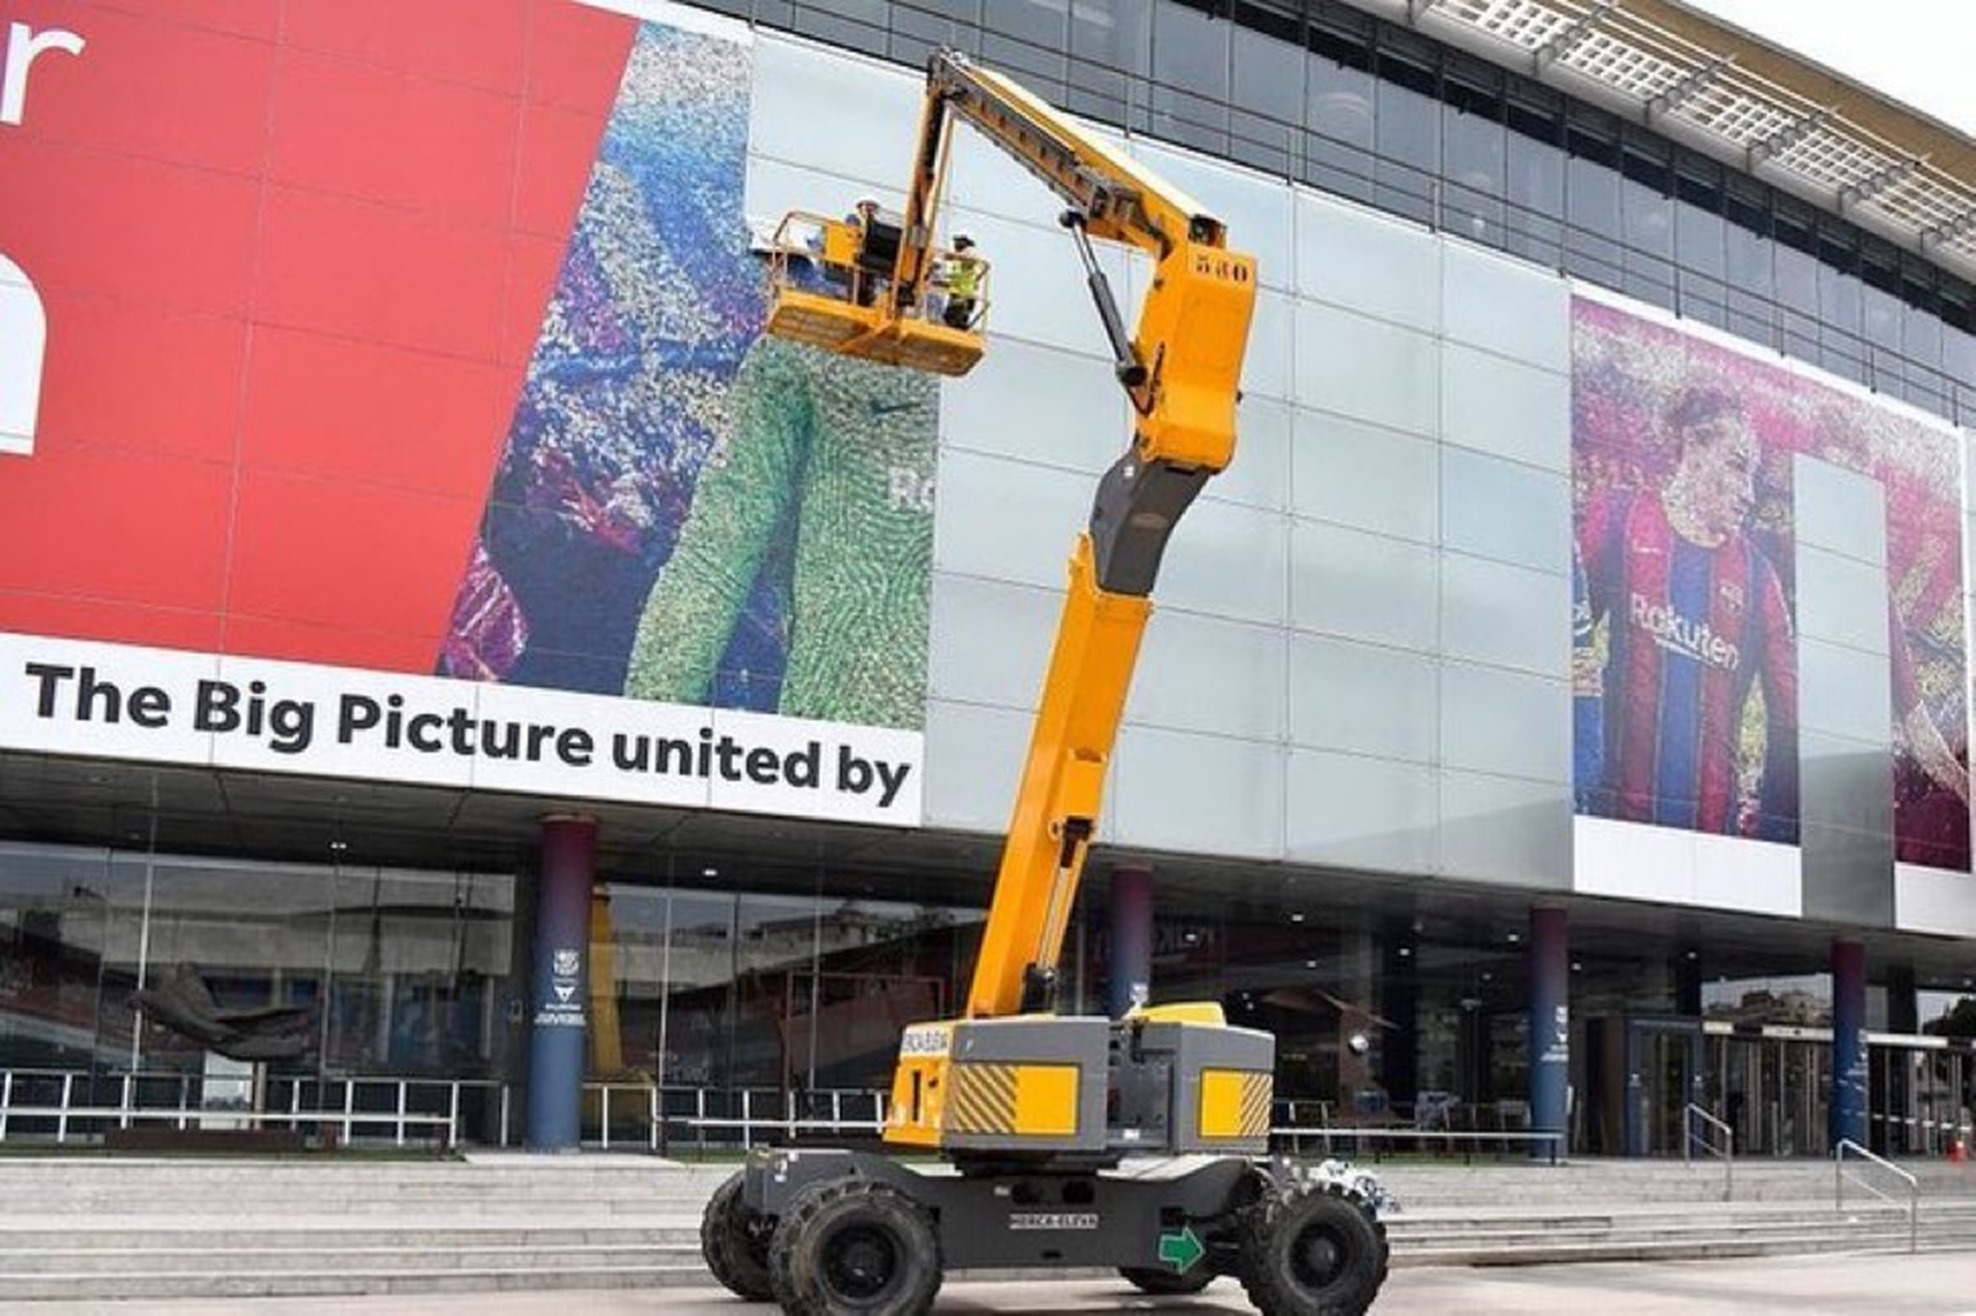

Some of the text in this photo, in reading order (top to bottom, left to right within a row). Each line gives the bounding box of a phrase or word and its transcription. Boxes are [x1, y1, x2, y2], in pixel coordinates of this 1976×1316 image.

[25, 662, 911, 807] The Big Picture united by
